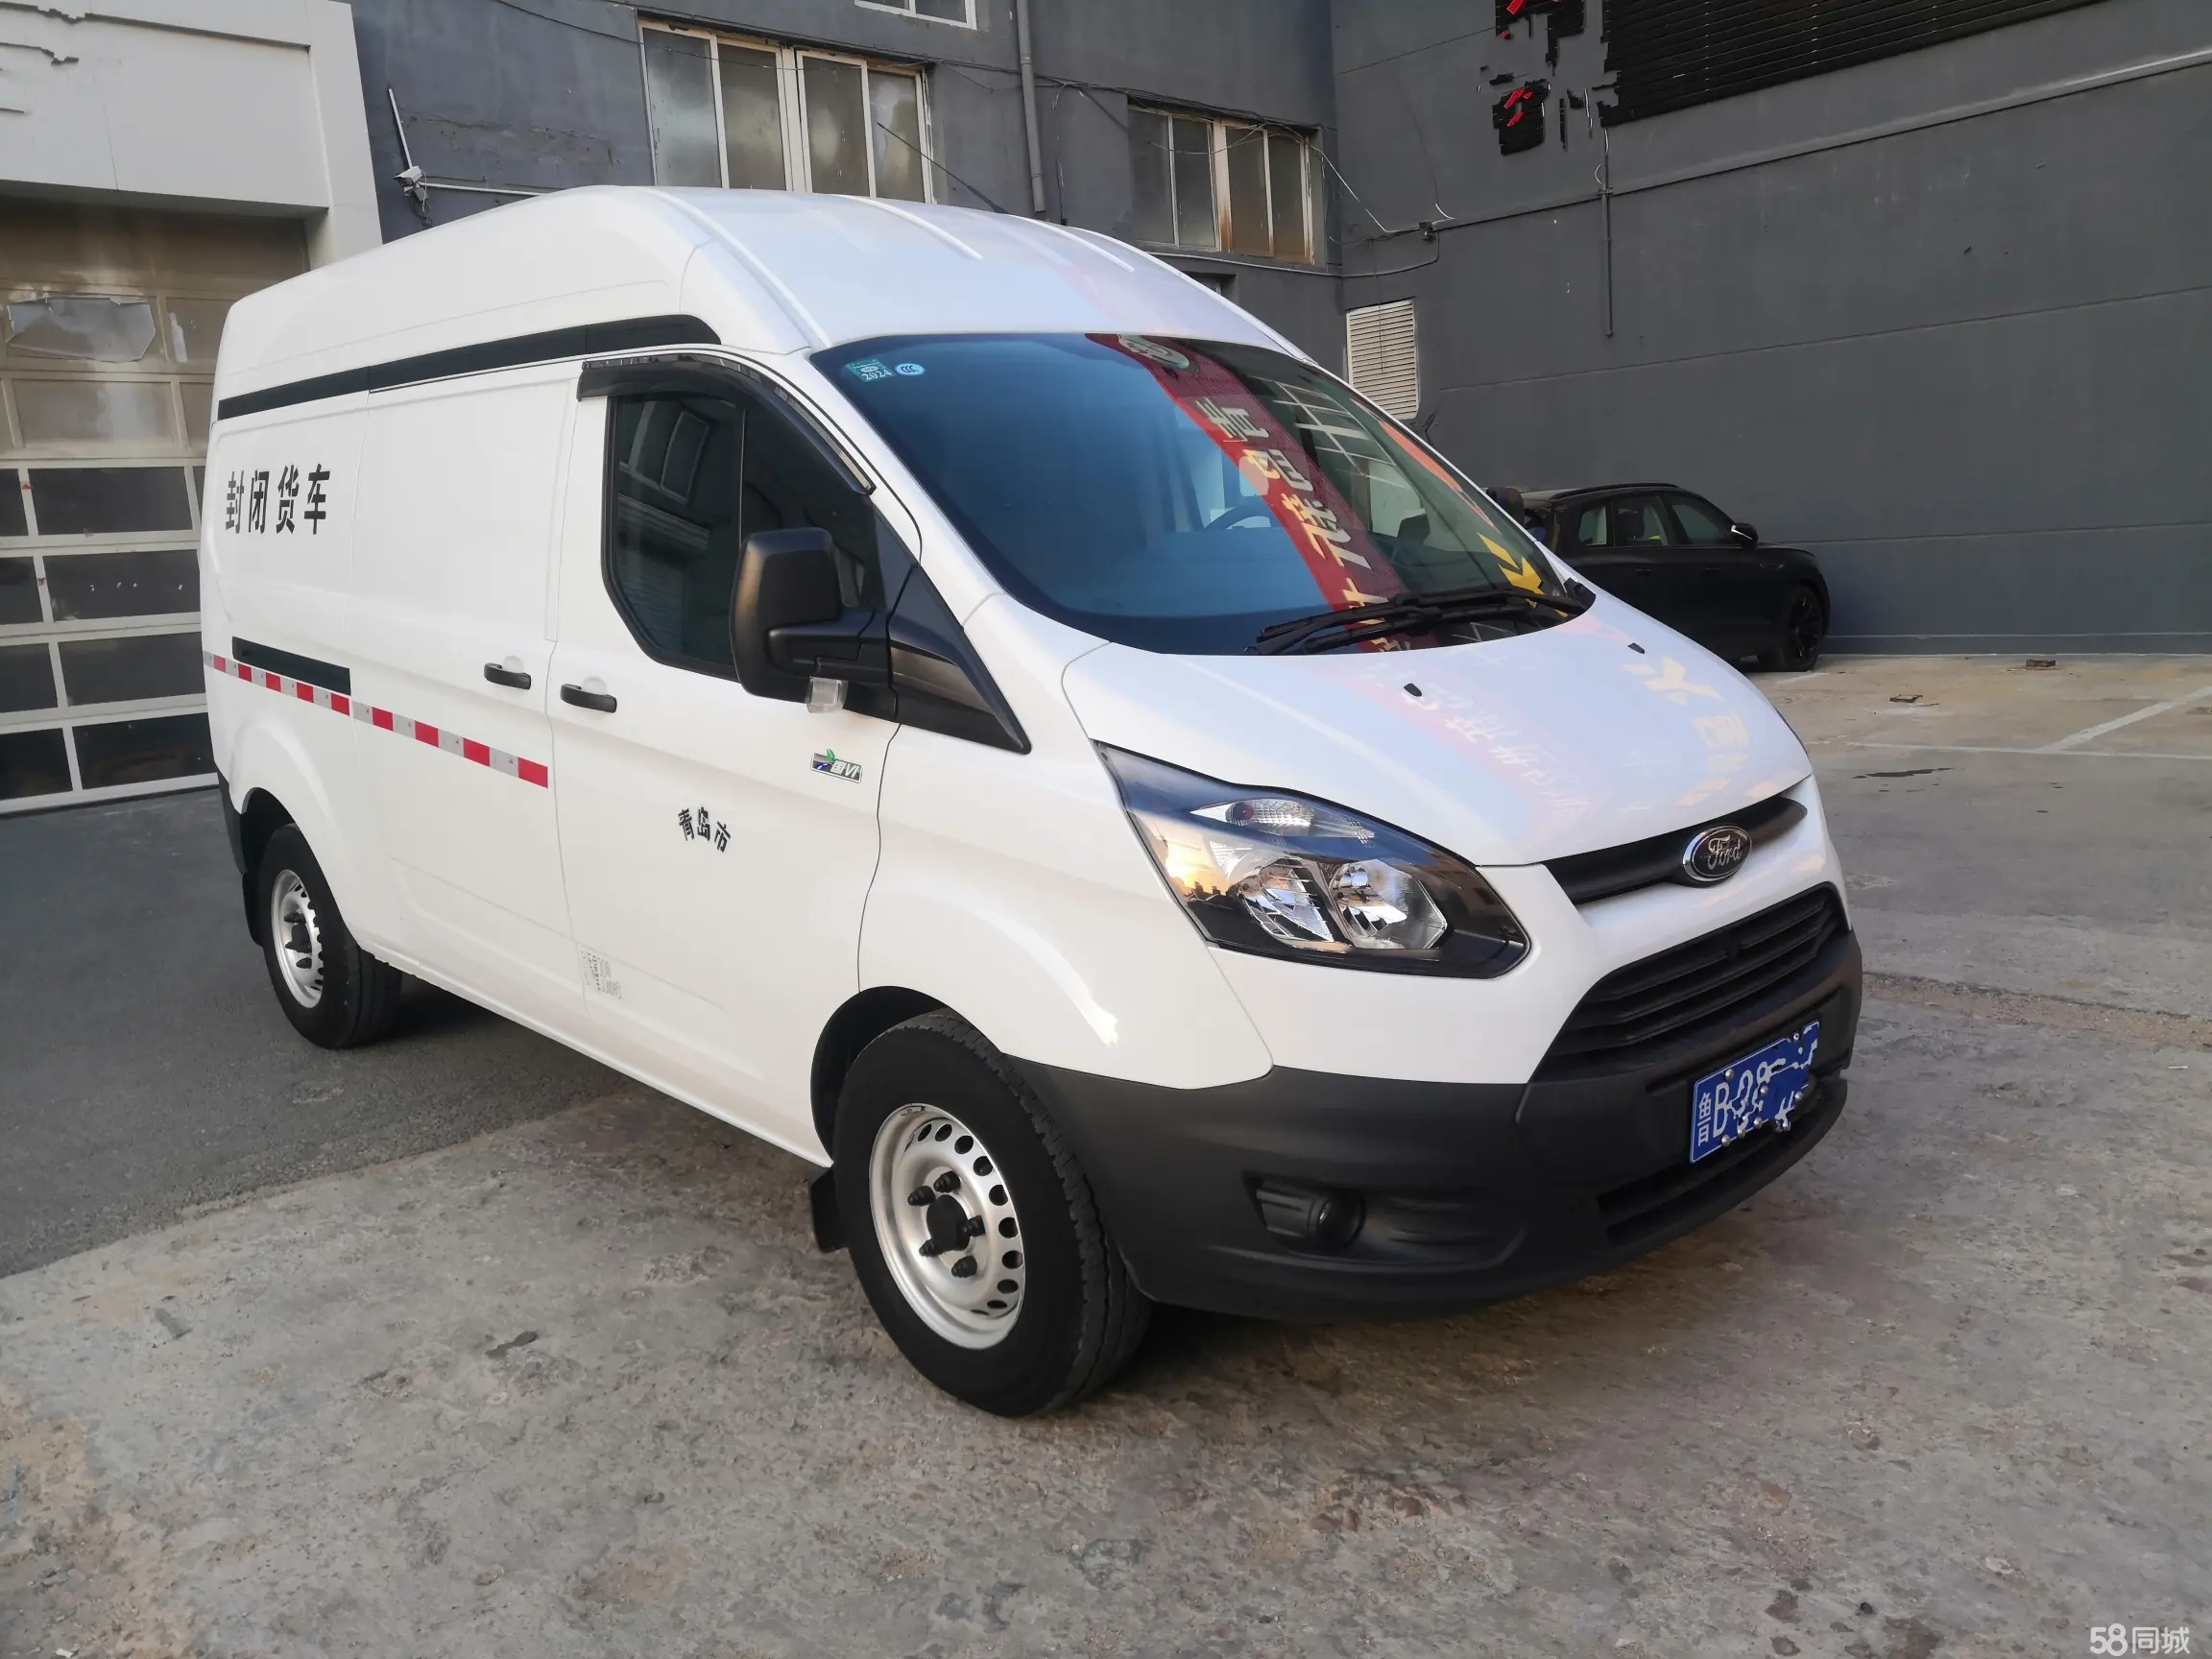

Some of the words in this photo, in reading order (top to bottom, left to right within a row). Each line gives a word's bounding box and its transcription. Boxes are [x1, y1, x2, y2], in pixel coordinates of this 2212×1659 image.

[861, 370, 892, 381] 2024
[225, 463, 331, 535] 封闭货车
[677, 805, 732, 854] 青岛市
[1704, 834, 1743, 871] Ford
